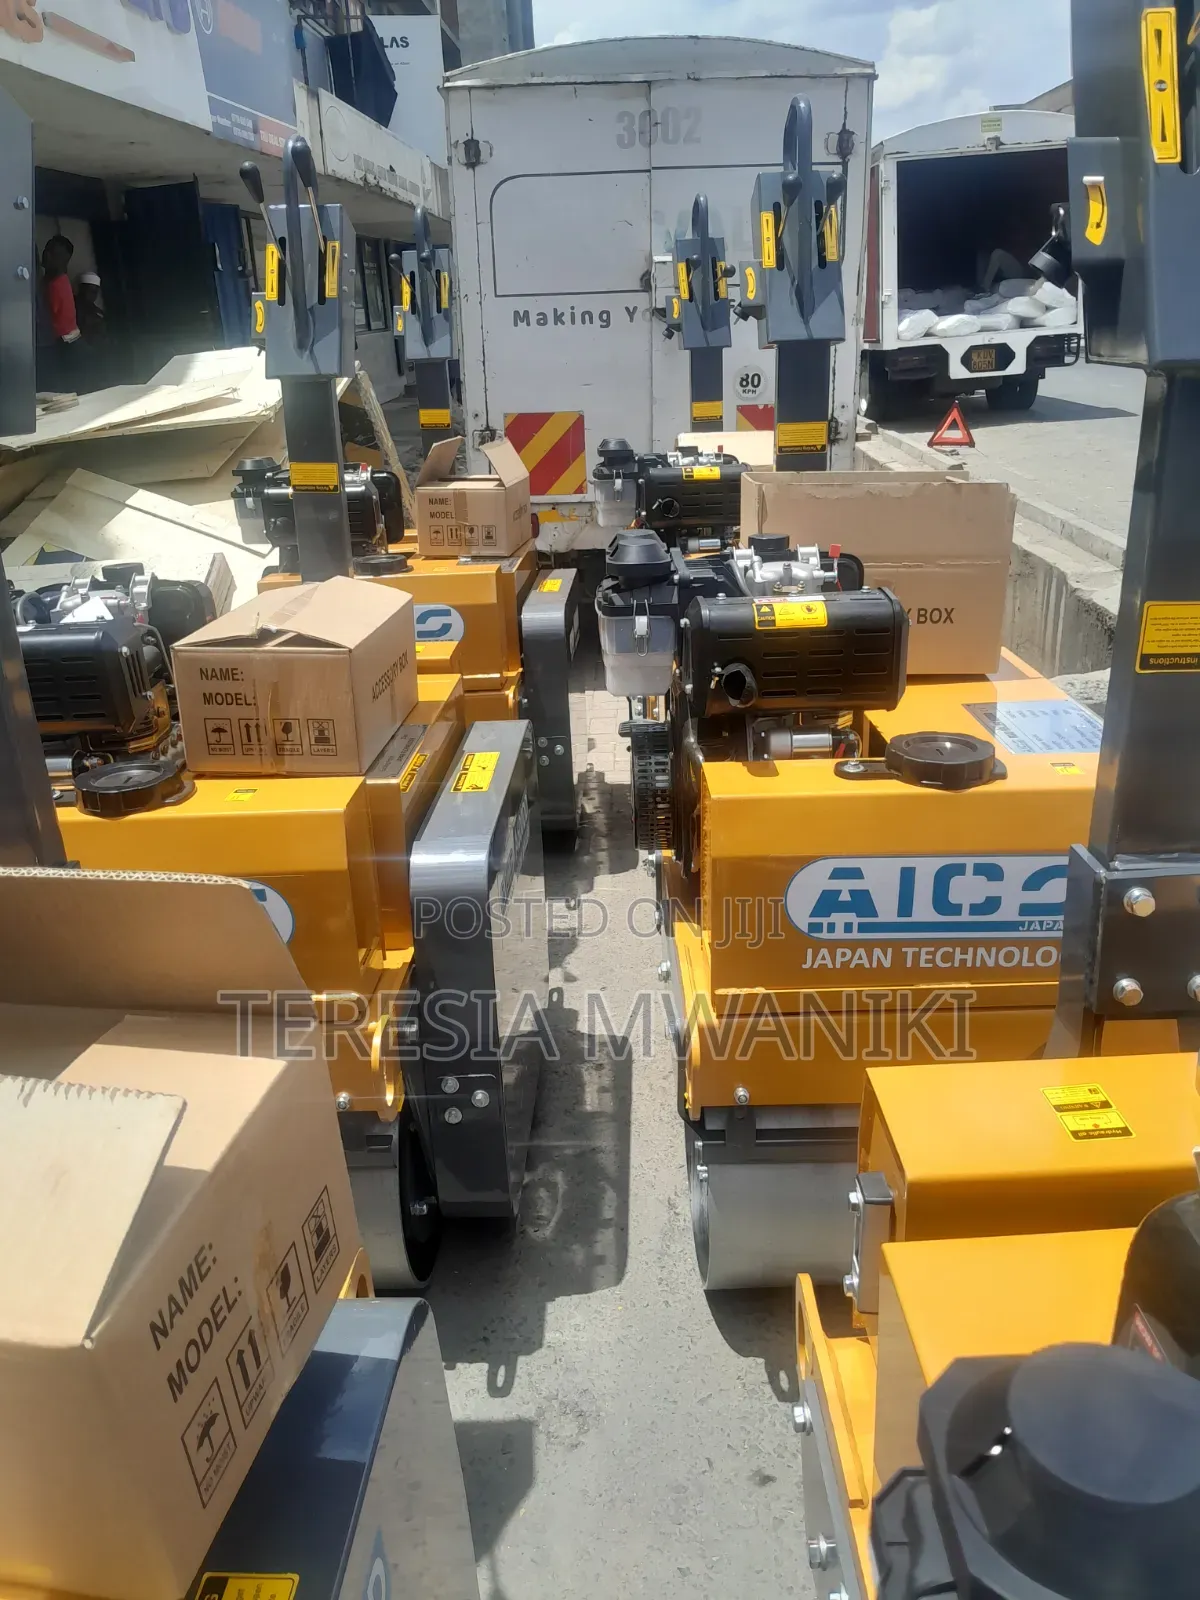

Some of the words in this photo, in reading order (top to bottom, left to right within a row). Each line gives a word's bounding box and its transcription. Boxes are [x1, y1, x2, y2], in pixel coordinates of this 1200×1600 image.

[615, 106, 702, 149] 3002
[513, 305, 611, 328] Making
[739, 372, 762, 389] 80
[428, 497, 452, 506] NAME:
[916, 607, 955, 625] BOX
[199, 667, 245, 682] NAME:
[202, 692, 257, 707] MODEL:
[801, 946, 893, 969] JAPAN
[902, 944, 1061, 968] TECHNOLO
[315, 1244, 338, 1283] LAYERS
[149, 1242, 217, 1351] NAME:
[166, 1276, 242, 1404] MODEL:
